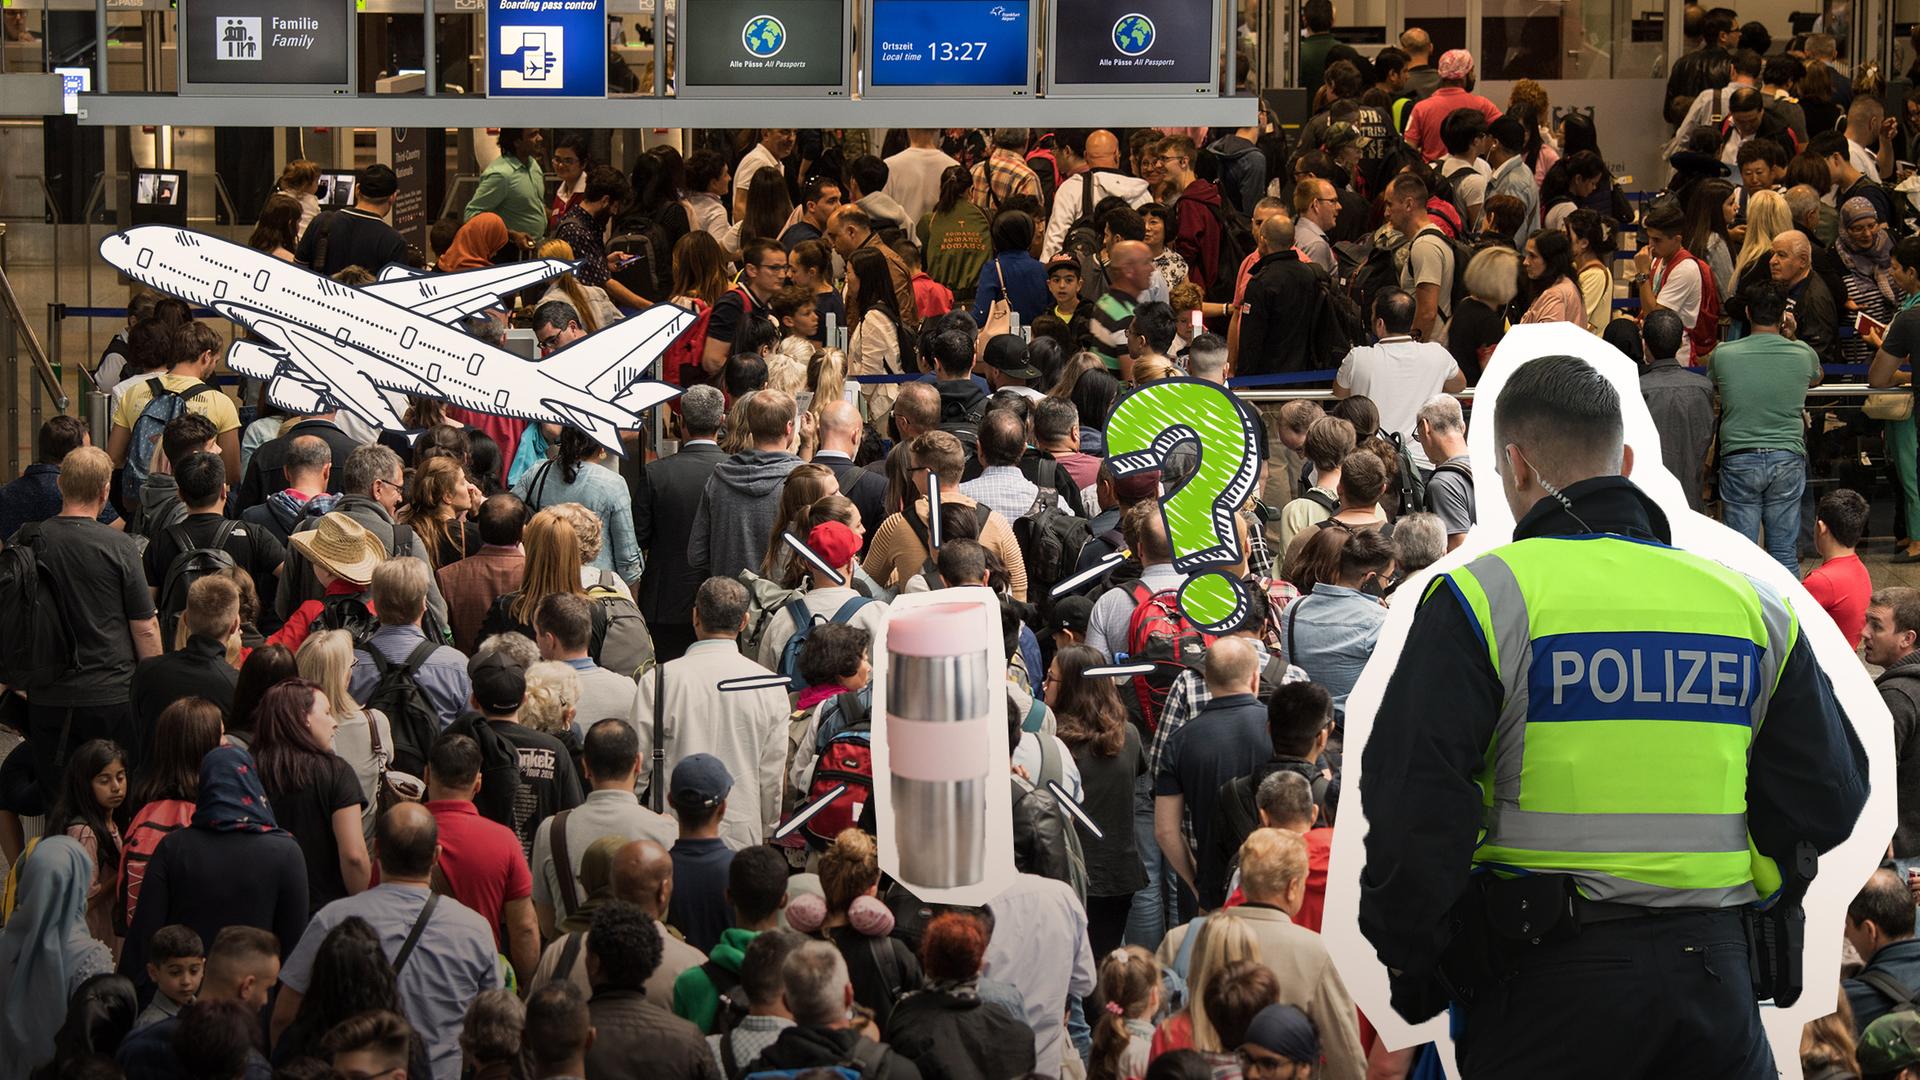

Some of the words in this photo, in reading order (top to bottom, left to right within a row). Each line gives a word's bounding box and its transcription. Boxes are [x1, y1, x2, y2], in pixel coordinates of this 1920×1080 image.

[500, 0, 540, 11] Boarding
[541, 1, 563, 11] pass
[564, 0, 597, 10] control
[272, 16, 319, 30] Familie
[271, 34, 315, 50] Family
[882, 41, 914, 51] Ortszeit
[882, 52, 903, 61] Local
[904, 52, 922, 61] time
[928, 42, 988, 61] 13:27
[729, 60, 743, 68] Alle
[744, 60, 763, 68] Pässe
[764, 60, 775, 68] All
[775, 60, 806, 69] Passports
[1099, 58, 1112, 66] Alle
[1113, 58, 1133, 66] Pässe
[1133, 58, 1144, 66] All
[1144, 58, 1175, 67] Passports
[1552, 648, 1751, 707] POLIZEI
[516, 748, 556, 770] nkelz
